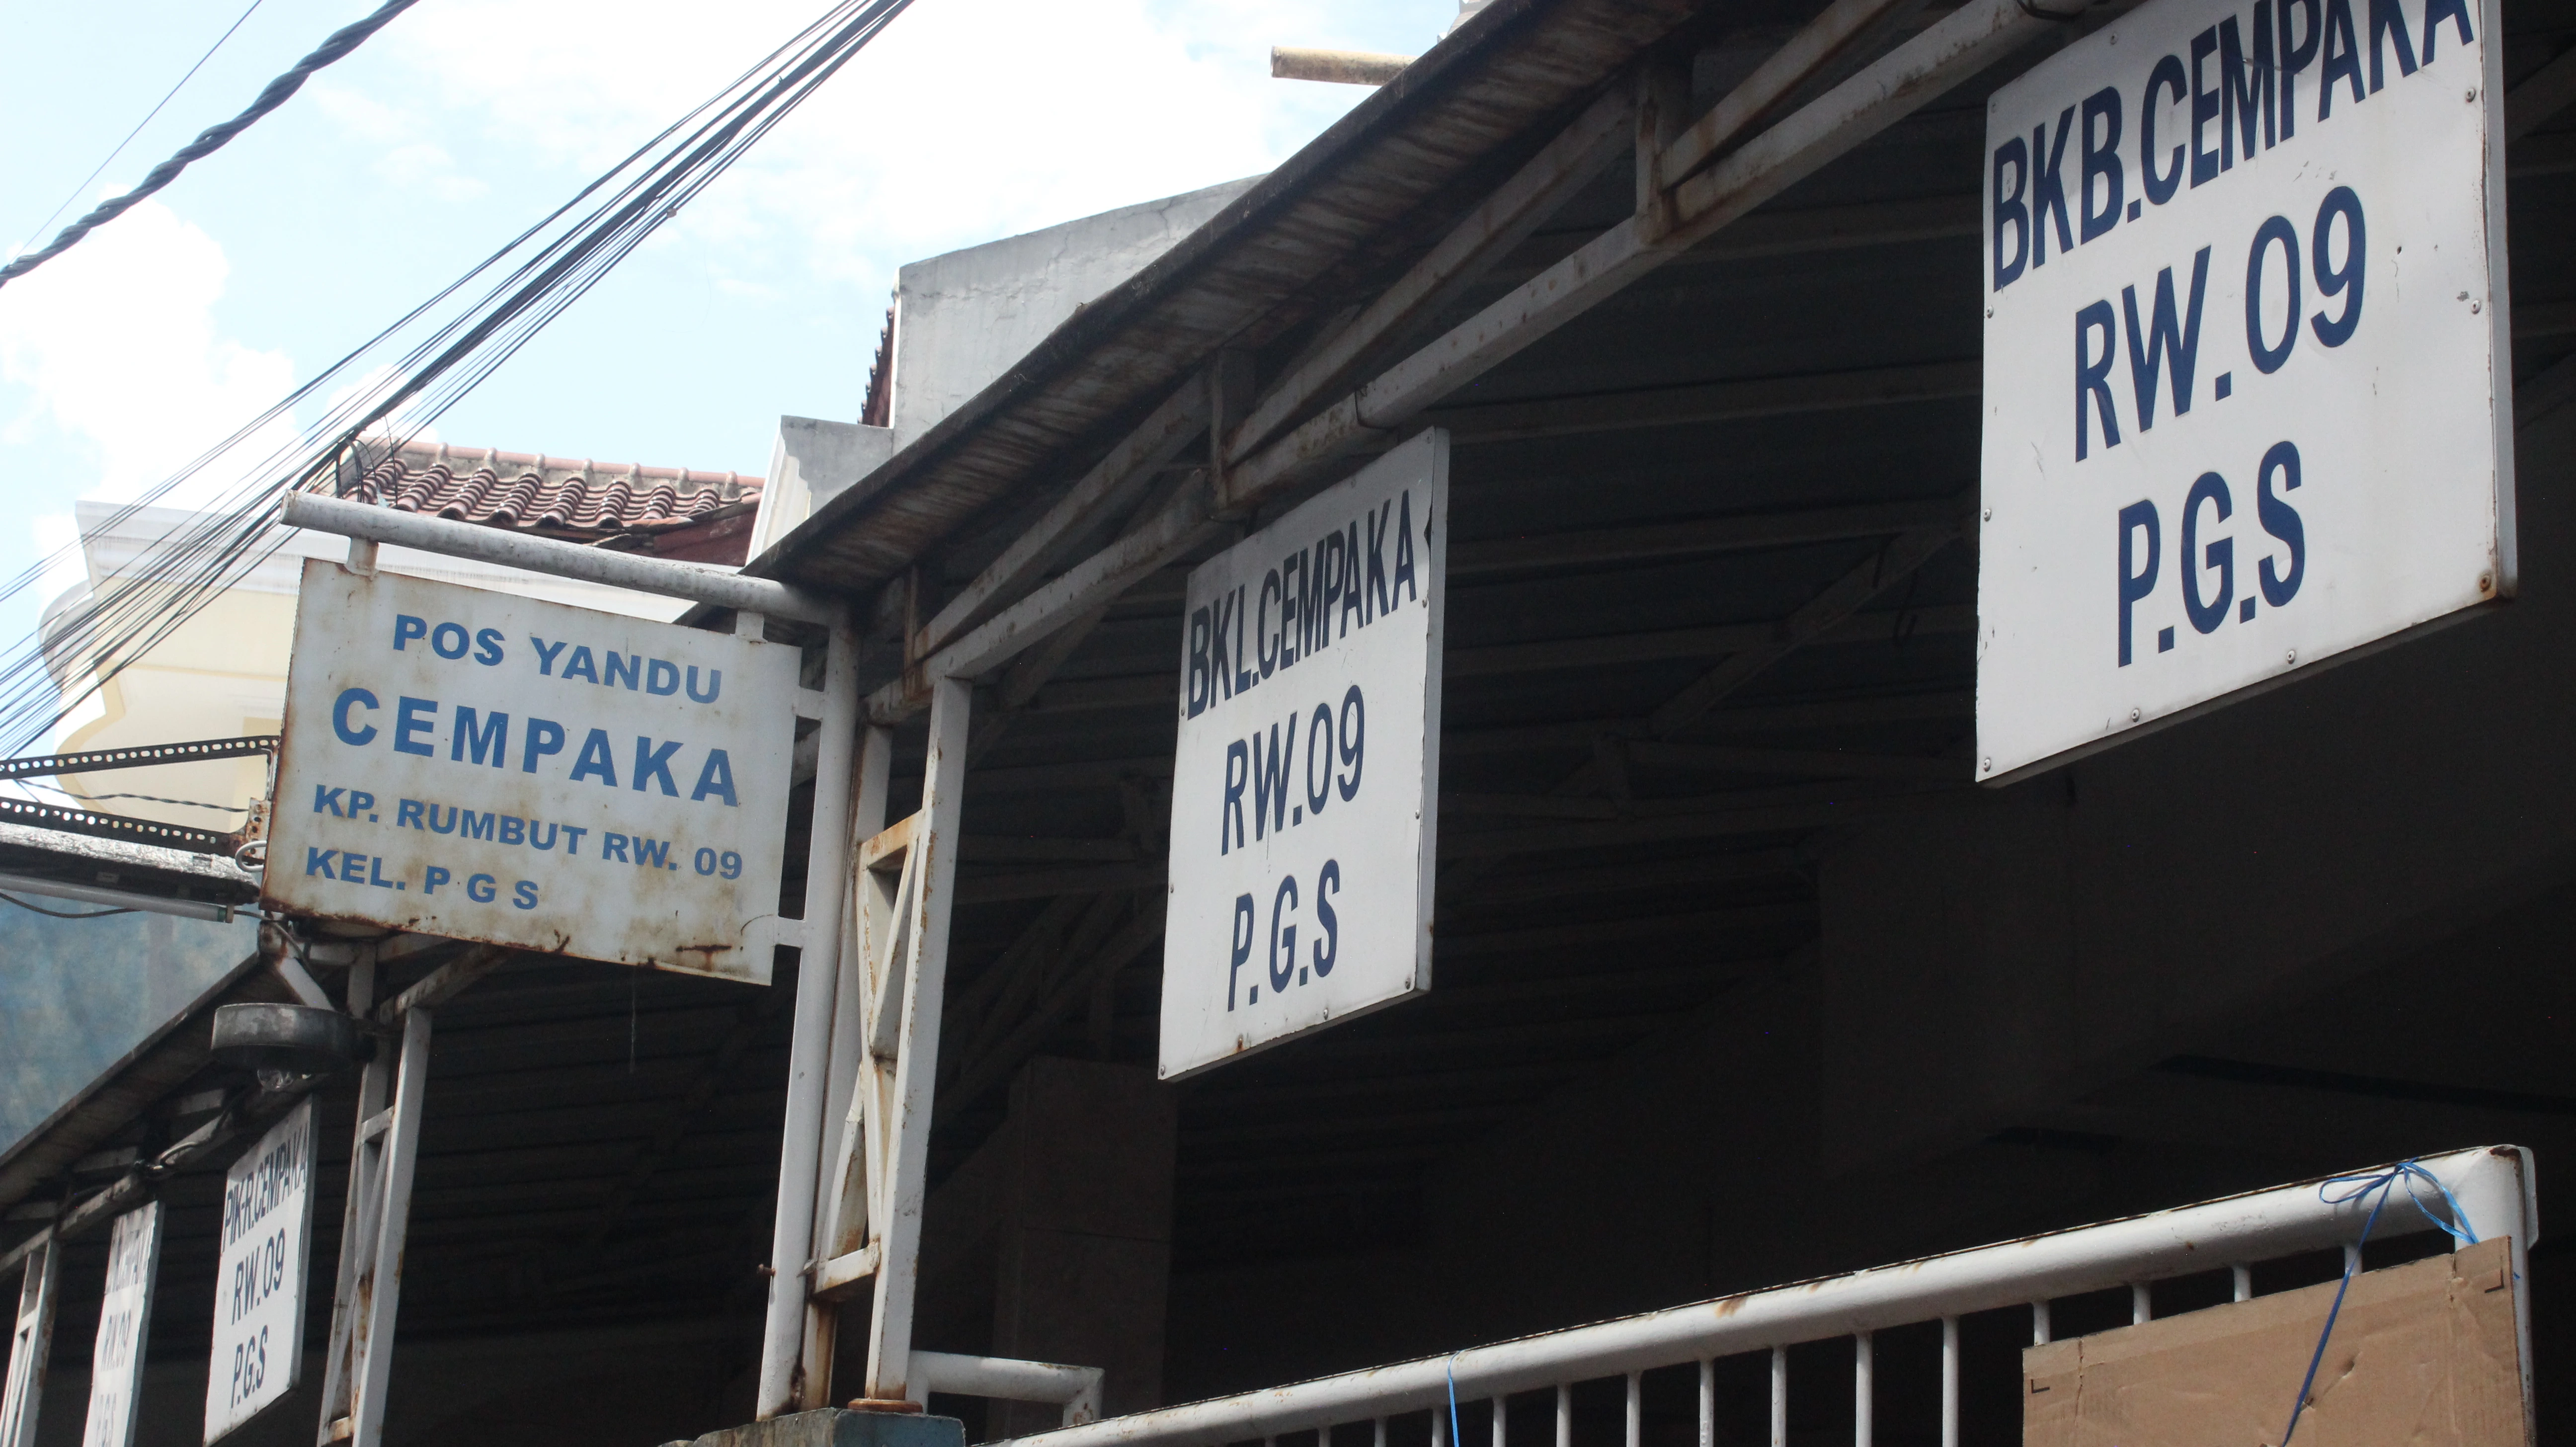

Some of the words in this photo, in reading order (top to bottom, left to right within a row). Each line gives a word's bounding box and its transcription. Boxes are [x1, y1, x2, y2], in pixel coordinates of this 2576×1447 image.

[1187, 489, 1417, 722] BKL.CEMPAKA
[2118, 440, 2306, 668] P.G.S
[392, 613, 505, 667] POS
[530, 637, 722, 704] YANDU
[332, 688, 739, 807] CEMPAKA
[1221, 684, 1365, 856] RW.09
[305, 847, 405, 891] KEL.
[313, 784, 379, 823] KP.
[397, 799, 588, 855] RUMBUT
[601, 831, 678, 871] RW.
[694, 847, 742, 880] 09
[1228, 859, 1340, 1012] P.G.S
[232, 1228, 286, 1325] RW.09
[231, 1325, 269, 1409] P.G.S
